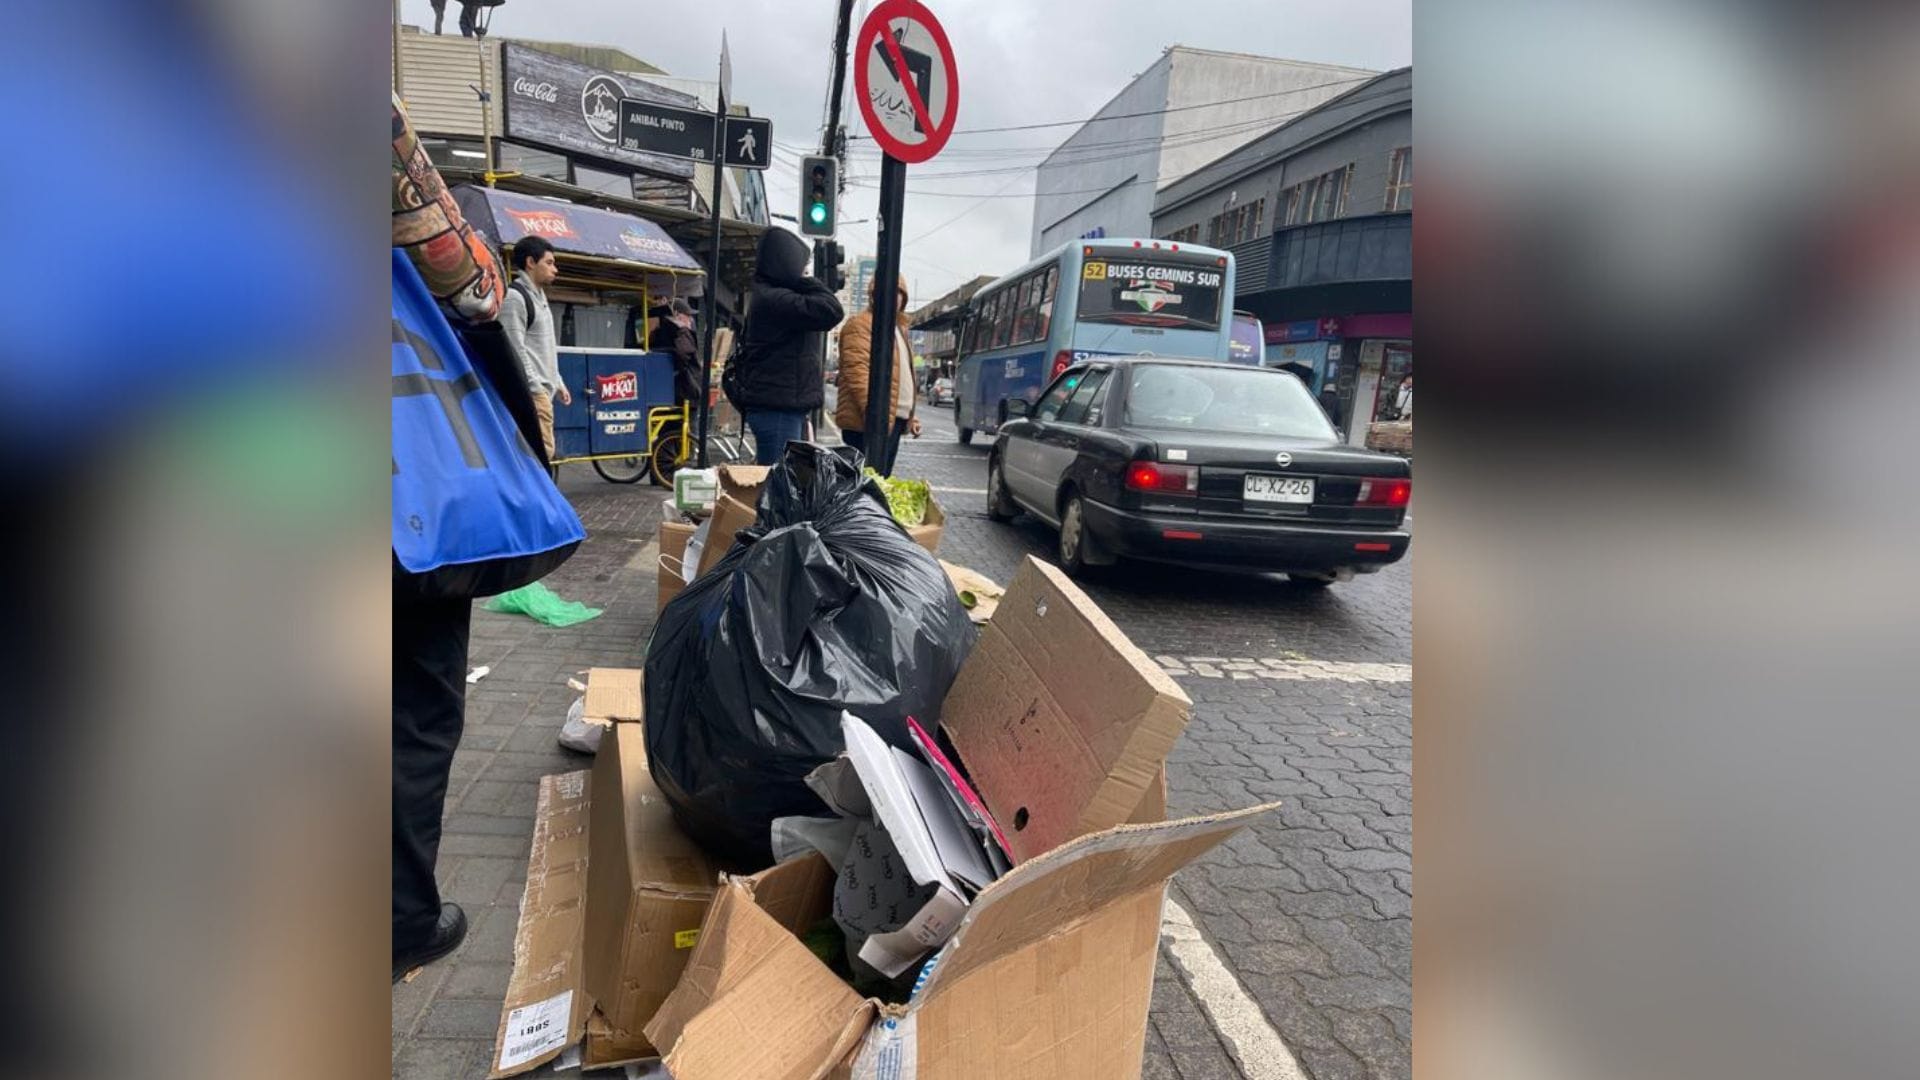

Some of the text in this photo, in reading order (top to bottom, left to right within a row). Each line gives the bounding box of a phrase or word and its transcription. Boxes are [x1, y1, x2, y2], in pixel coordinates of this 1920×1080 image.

[629, 113, 686, 132] ANIBAL PINTO
[1085, 264, 1104, 277] 52
[1107, 265, 1221, 287] BUSES GEMINIS SUR
